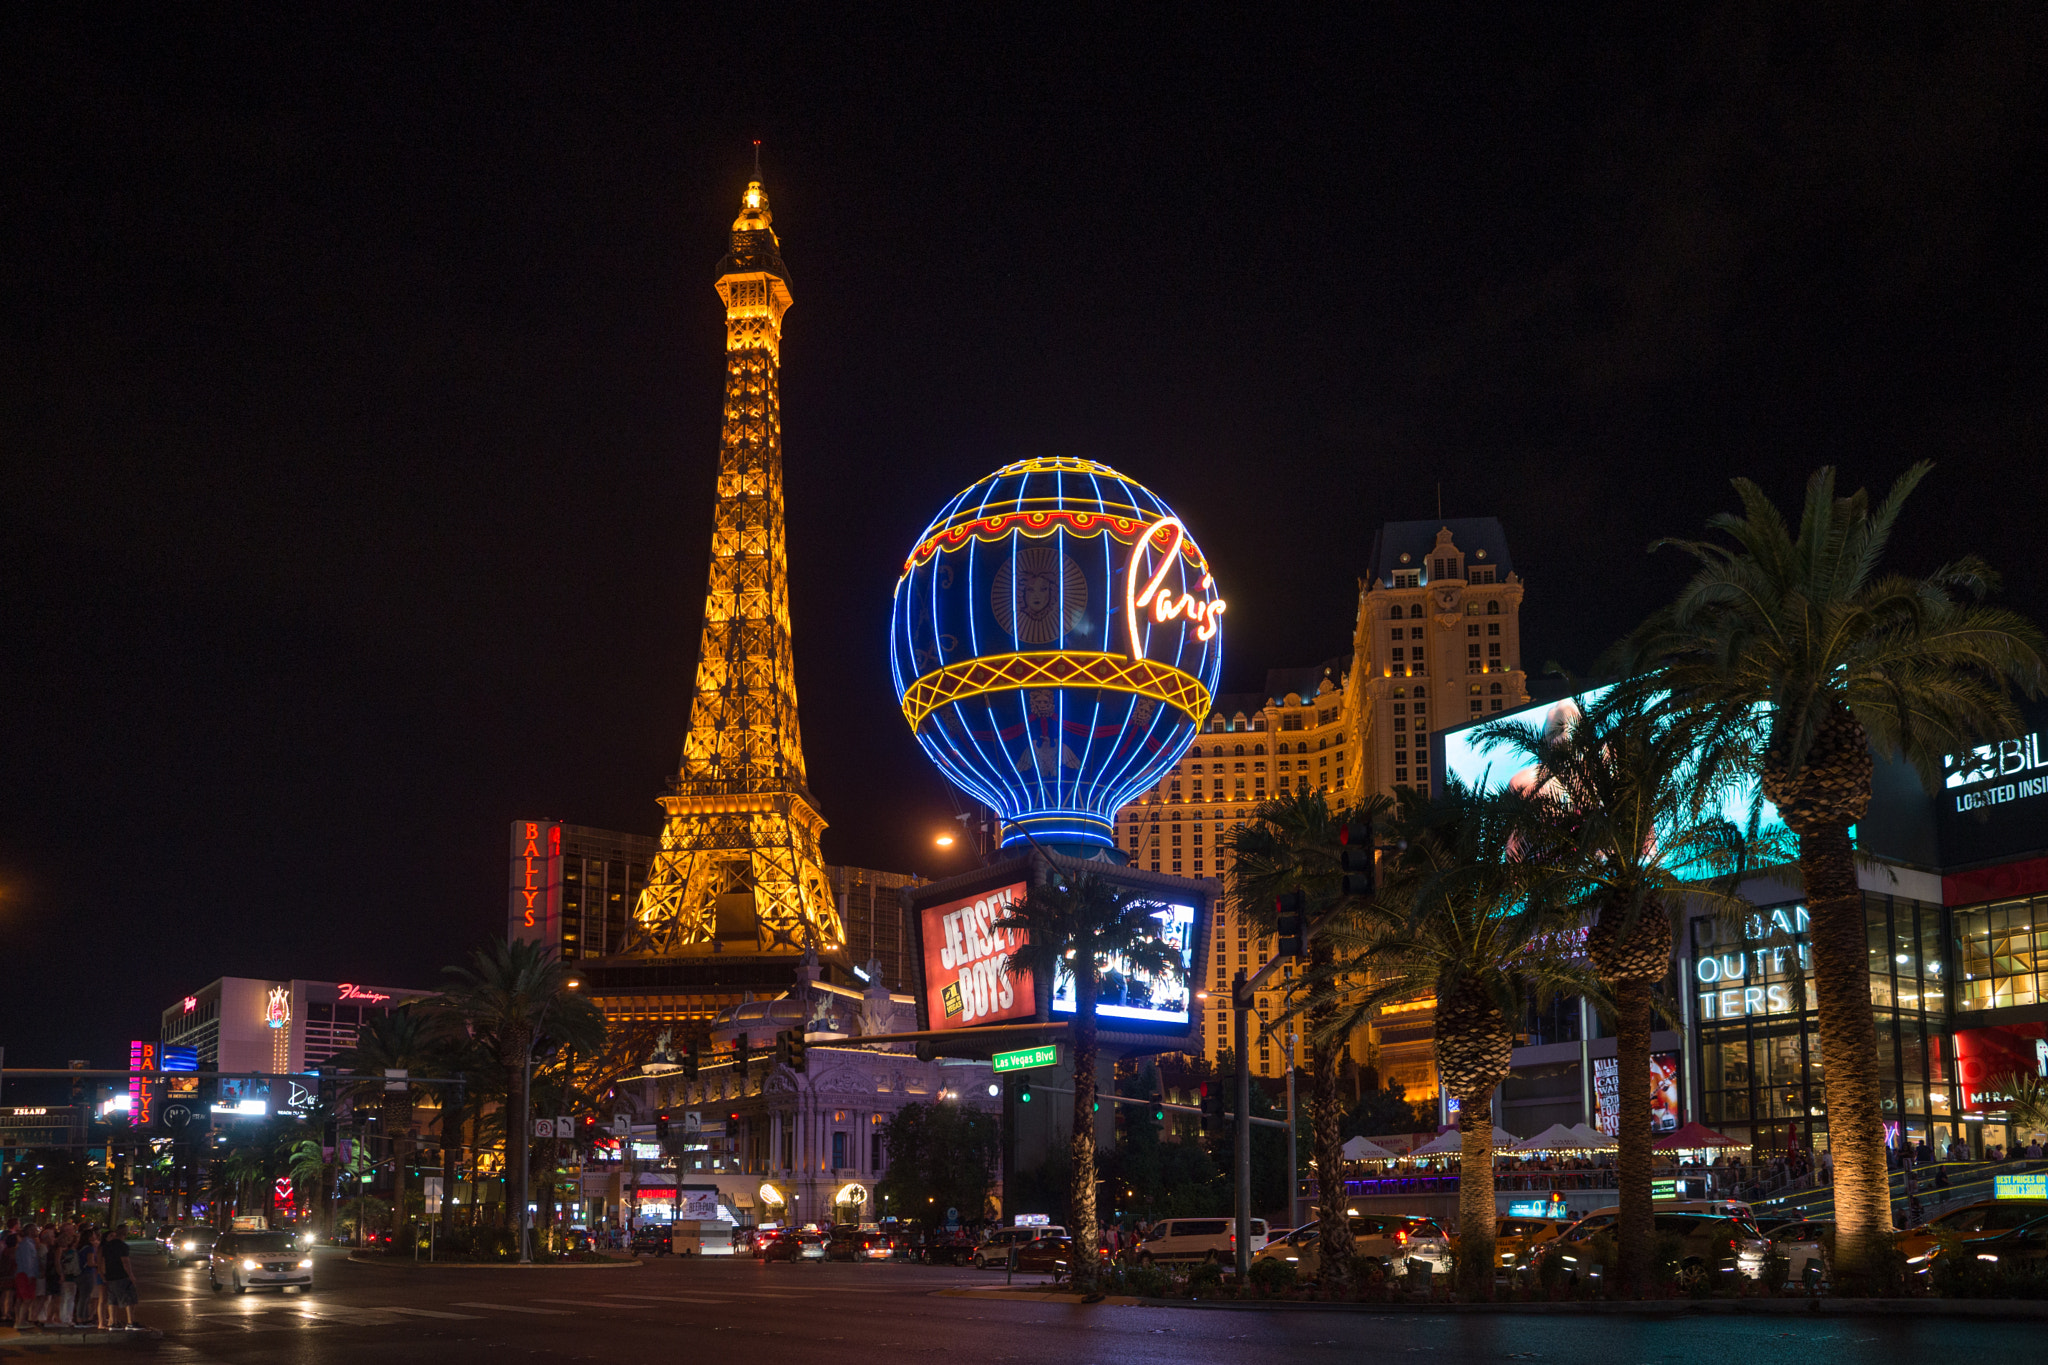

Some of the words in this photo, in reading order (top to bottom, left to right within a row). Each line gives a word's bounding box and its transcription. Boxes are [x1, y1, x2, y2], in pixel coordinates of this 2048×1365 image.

[1126, 516, 1226, 660] Paris
[1956, 784, 2016, 812] LOCATED
[2018, 775, 2048, 798] INSI
[522, 822, 541, 928] BALLYS
[941, 888, 1015, 970] JERSEY
[1697, 943, 1813, 983] OUTFI
[337, 983, 390, 1004] Flamingo
[958, 953, 1014, 1022] BOYS
[946, 1001, 962, 1013] VEGAS
[1698, 985, 1786, 1018] TERS
[995, 1058, 1009, 1068] Las
[1010, 1054, 1034, 1068] Vegas
[1035, 1050, 1054, 1062] Blvd
[1597, 1076, 1619, 1087] CAB
[1601, 1104, 1620, 1116] FOO
[1996, 1175, 2011, 1184] BEST
[2012, 1175, 2035, 1184] PRICES
[2036, 1174, 2046, 1183] ON
[1997, 1184, 2025, 1194] TONIGHT'S
[2026, 1183, 2047, 1193] SHOWS
